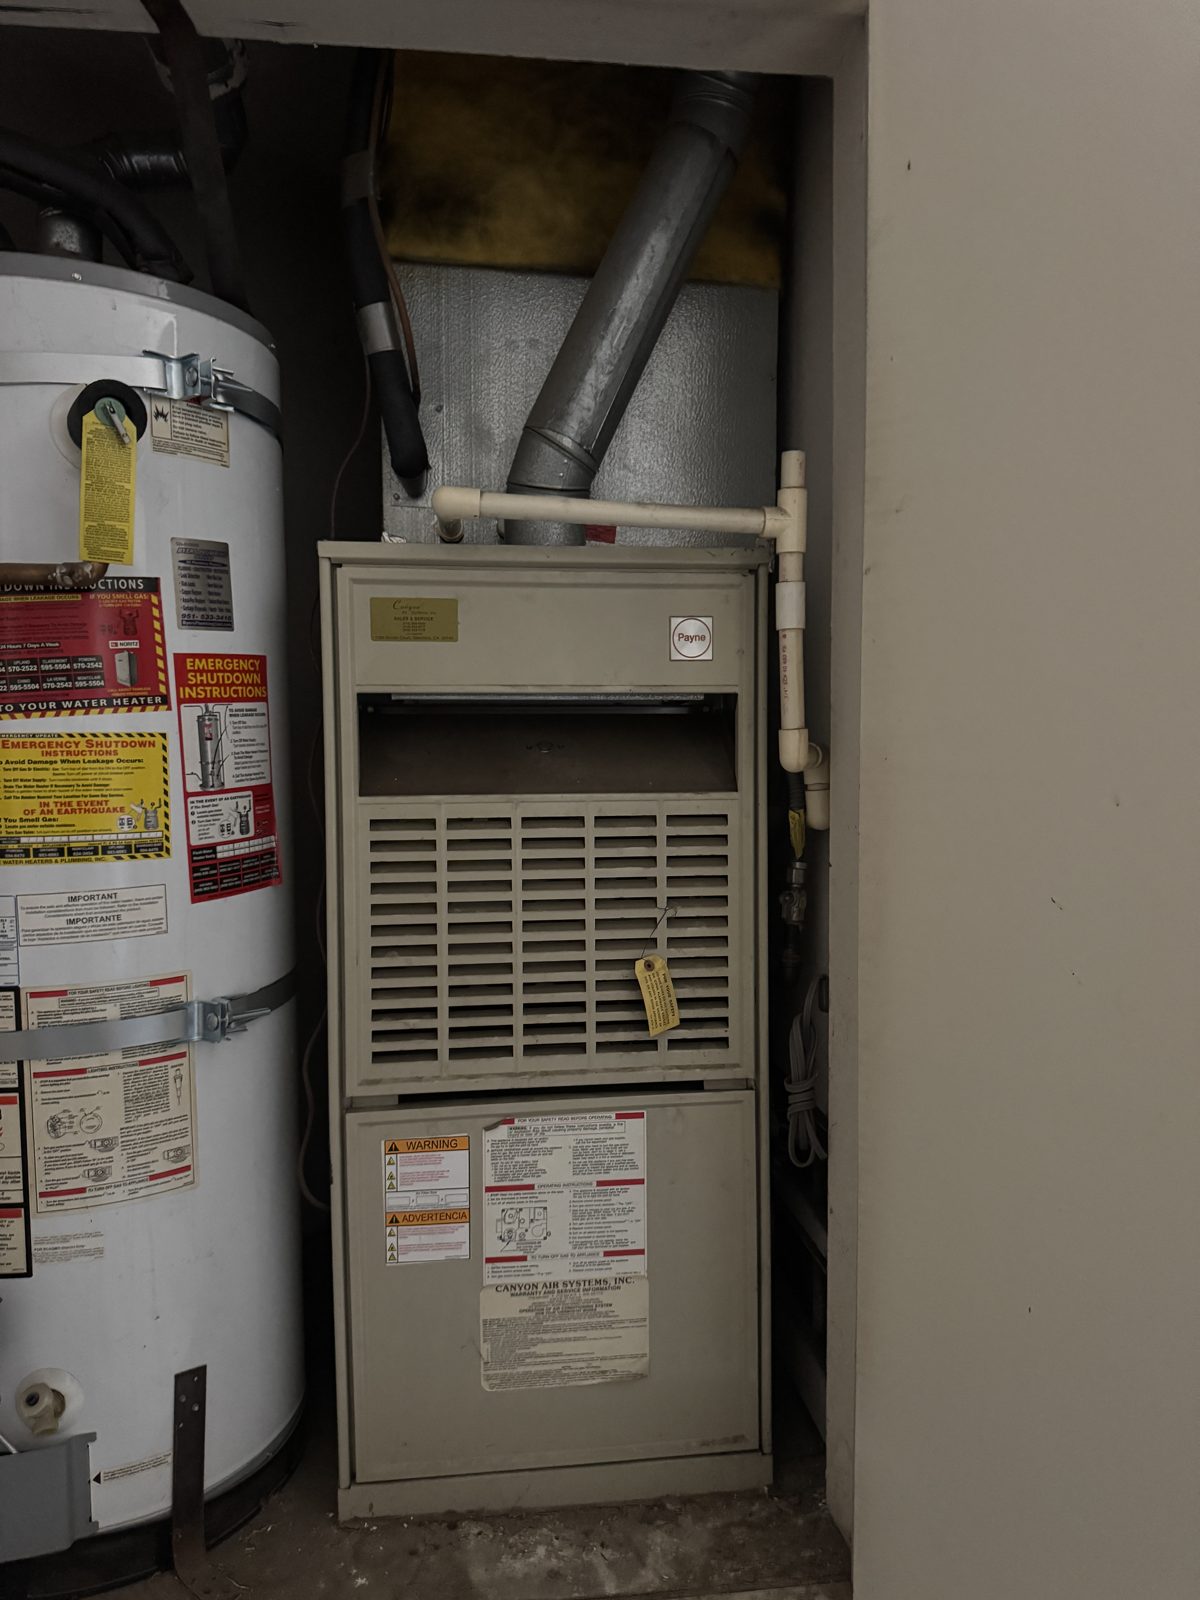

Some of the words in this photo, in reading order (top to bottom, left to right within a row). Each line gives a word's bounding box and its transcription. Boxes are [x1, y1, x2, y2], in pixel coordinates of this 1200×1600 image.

[678, 633, 706, 643] Payne
[186, 658, 260, 670] EMERGENCY
[188, 672, 260, 684] SHUTDOWN
[179, 686, 266, 699] INSTRUCTIONS
[19, 702, 56, 711] YOUR
[61, 699, 107, 708] WATER
[113, 696, 162, 706] HEATER
[2, 740, 81, 749] EMERGENCY
[85, 740, 156, 748] SHUTDOWN
[57, 807, 126, 815] EARTHQUAKE
[68, 892, 118, 903] IMPORTANT
[66, 914, 122, 925] IMPORTANTE
[406, 1139, 458, 1150] WARNING
[402, 1212, 467, 1223] ADVERTENCIA
[496, 1283, 539, 1293] CANYON
[563, 1279, 611, 1288] SYSTEMS,
[614, 1276, 635, 1284] INC.
